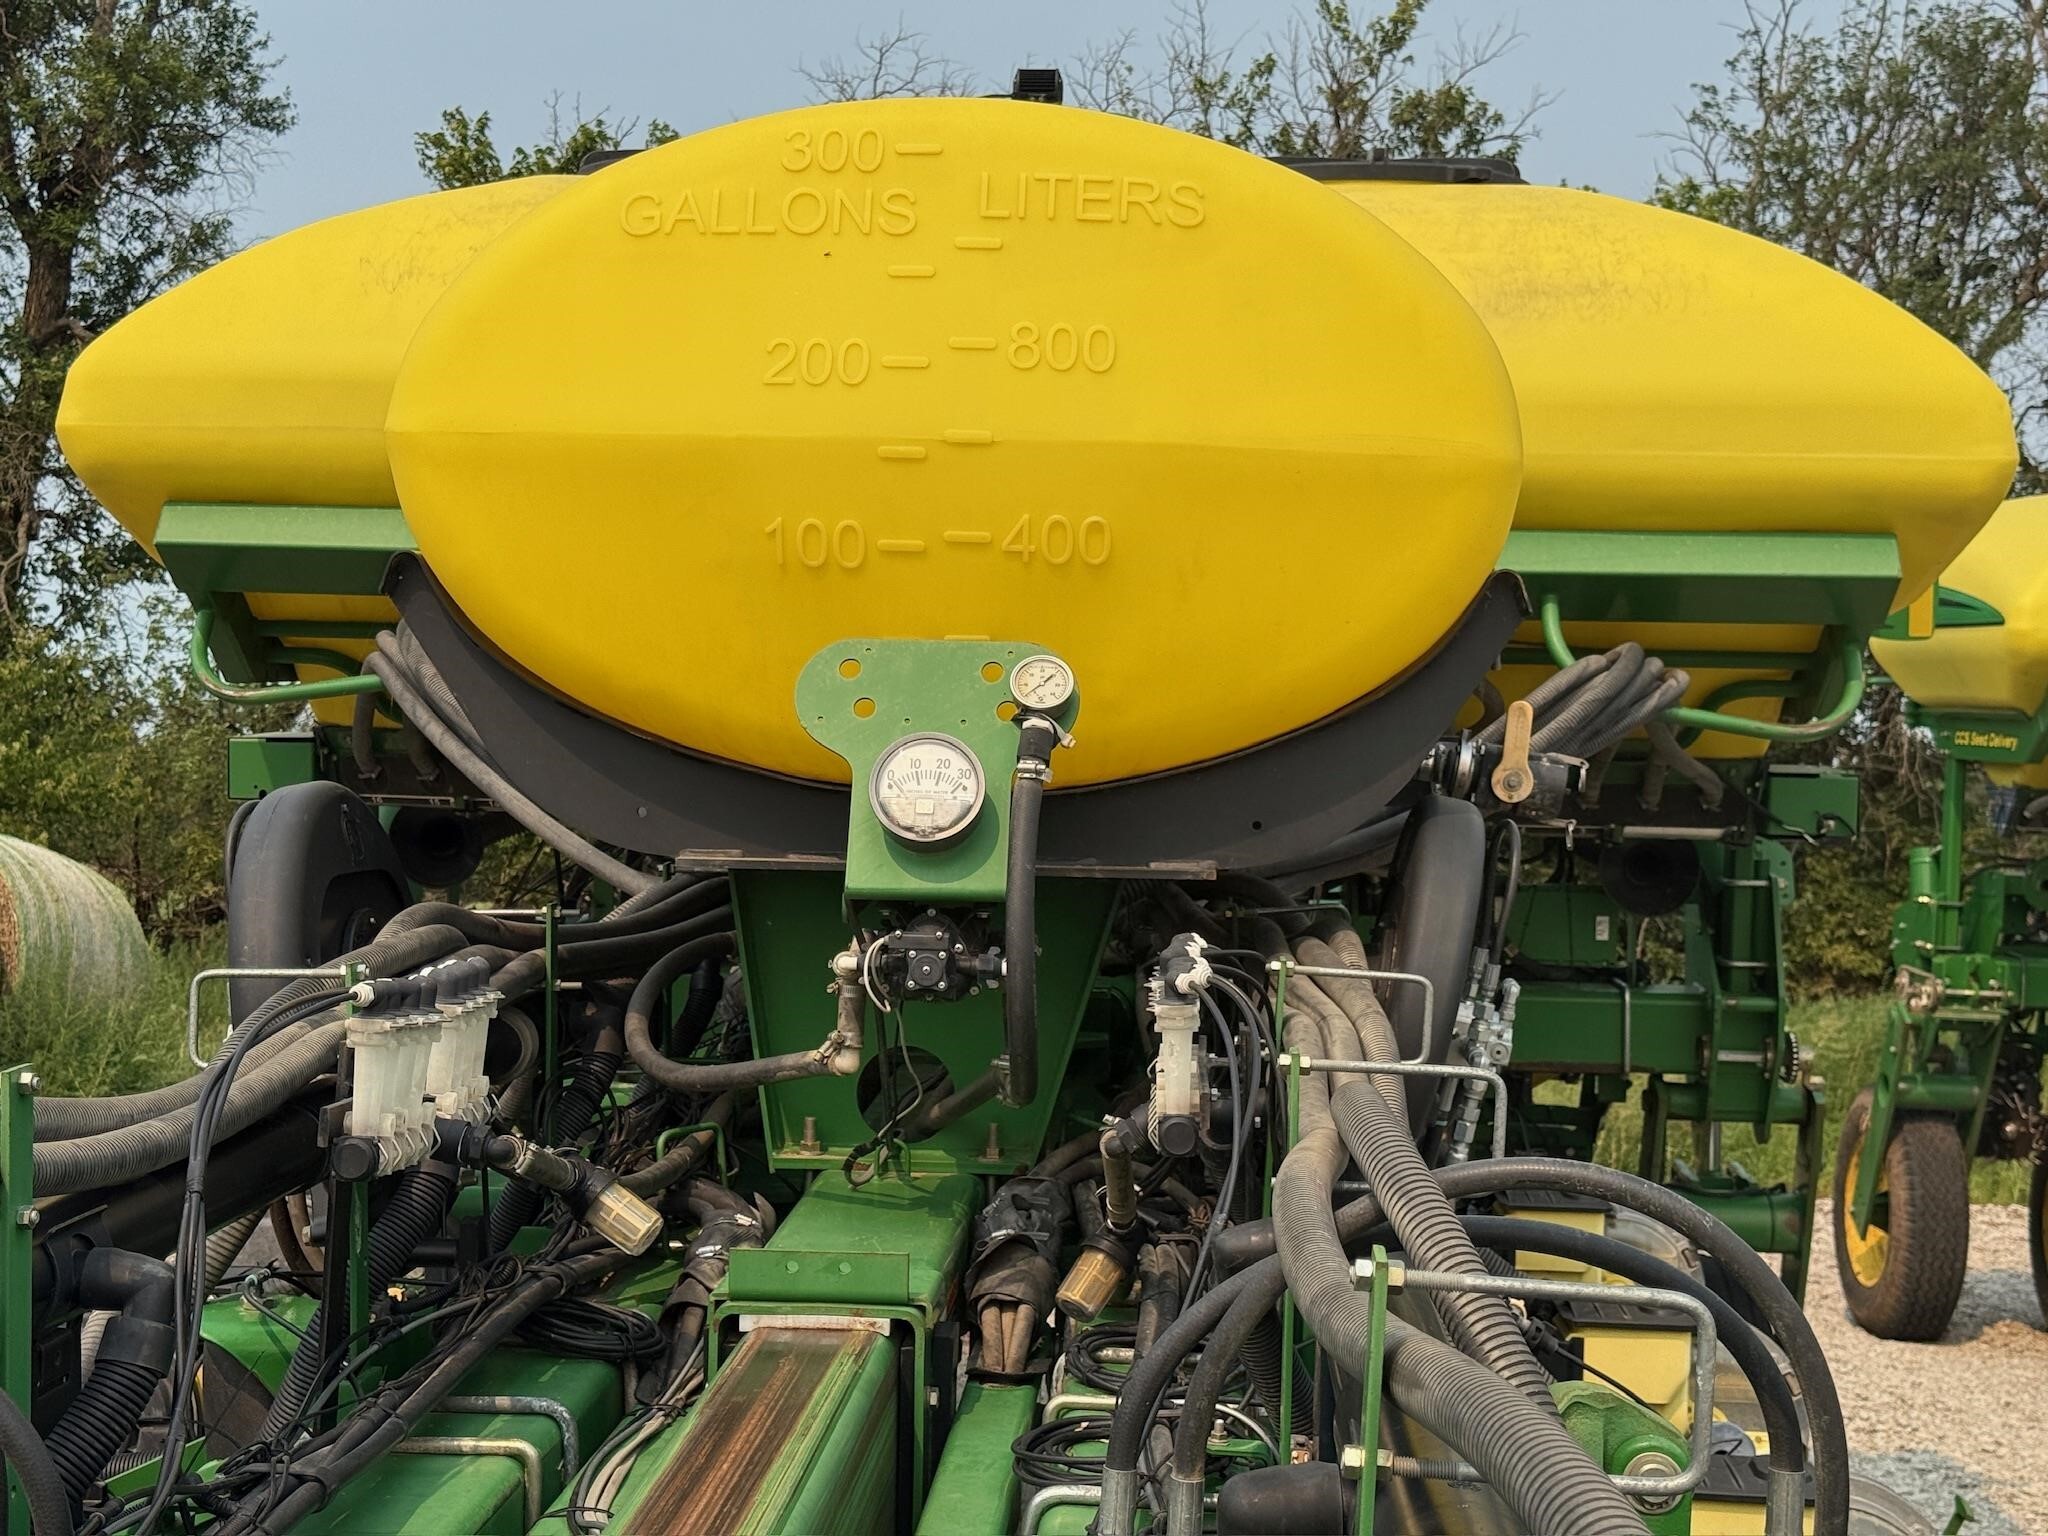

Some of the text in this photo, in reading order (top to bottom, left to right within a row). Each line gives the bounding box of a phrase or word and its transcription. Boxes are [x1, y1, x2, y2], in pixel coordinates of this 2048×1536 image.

[781, 129, 885, 172] 300
[619, 187, 918, 237] GALLONS
[980, 171, 1206, 228] LITERS
[763, 337, 871, 386] 200
[1006, 321, 1116, 373] 800
[764, 516, 868, 569] 100
[1001, 513, 1112, 566] 400
[910, 758, 921, 770] 10
[936, 758, 951, 770] 20
[1971, 731, 1988, 746] Seed
[1989, 732, 2017, 751] Delivery
[887, 769, 895, 781] 0
[957, 768, 972, 780] 30
